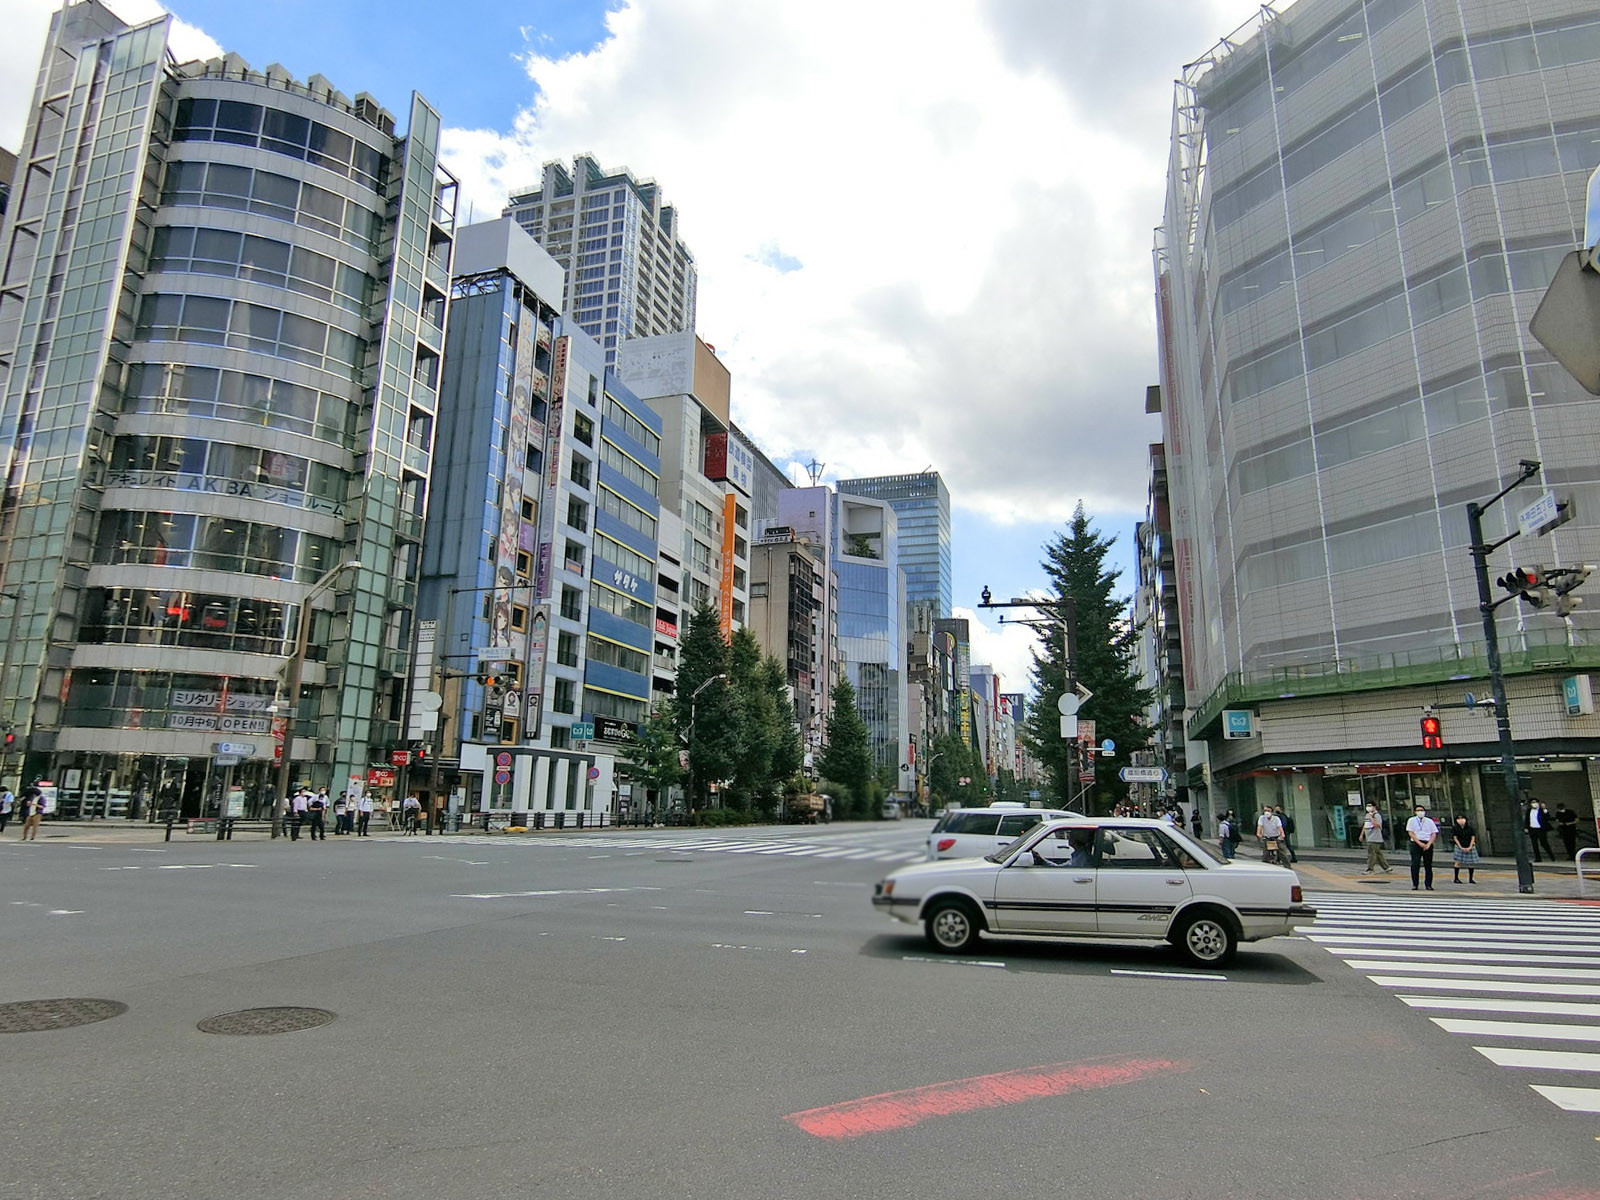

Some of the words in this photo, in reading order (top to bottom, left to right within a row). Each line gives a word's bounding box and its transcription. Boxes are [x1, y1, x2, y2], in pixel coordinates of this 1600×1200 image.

[109, 473, 176, 487] アキュレイト
[264, 488, 344, 516] ショールーム
[614, 569, 638, 593] サタケ
[171, 716, 216, 729] 10月中旬
[223, 719, 265, 730] OPEN!!
